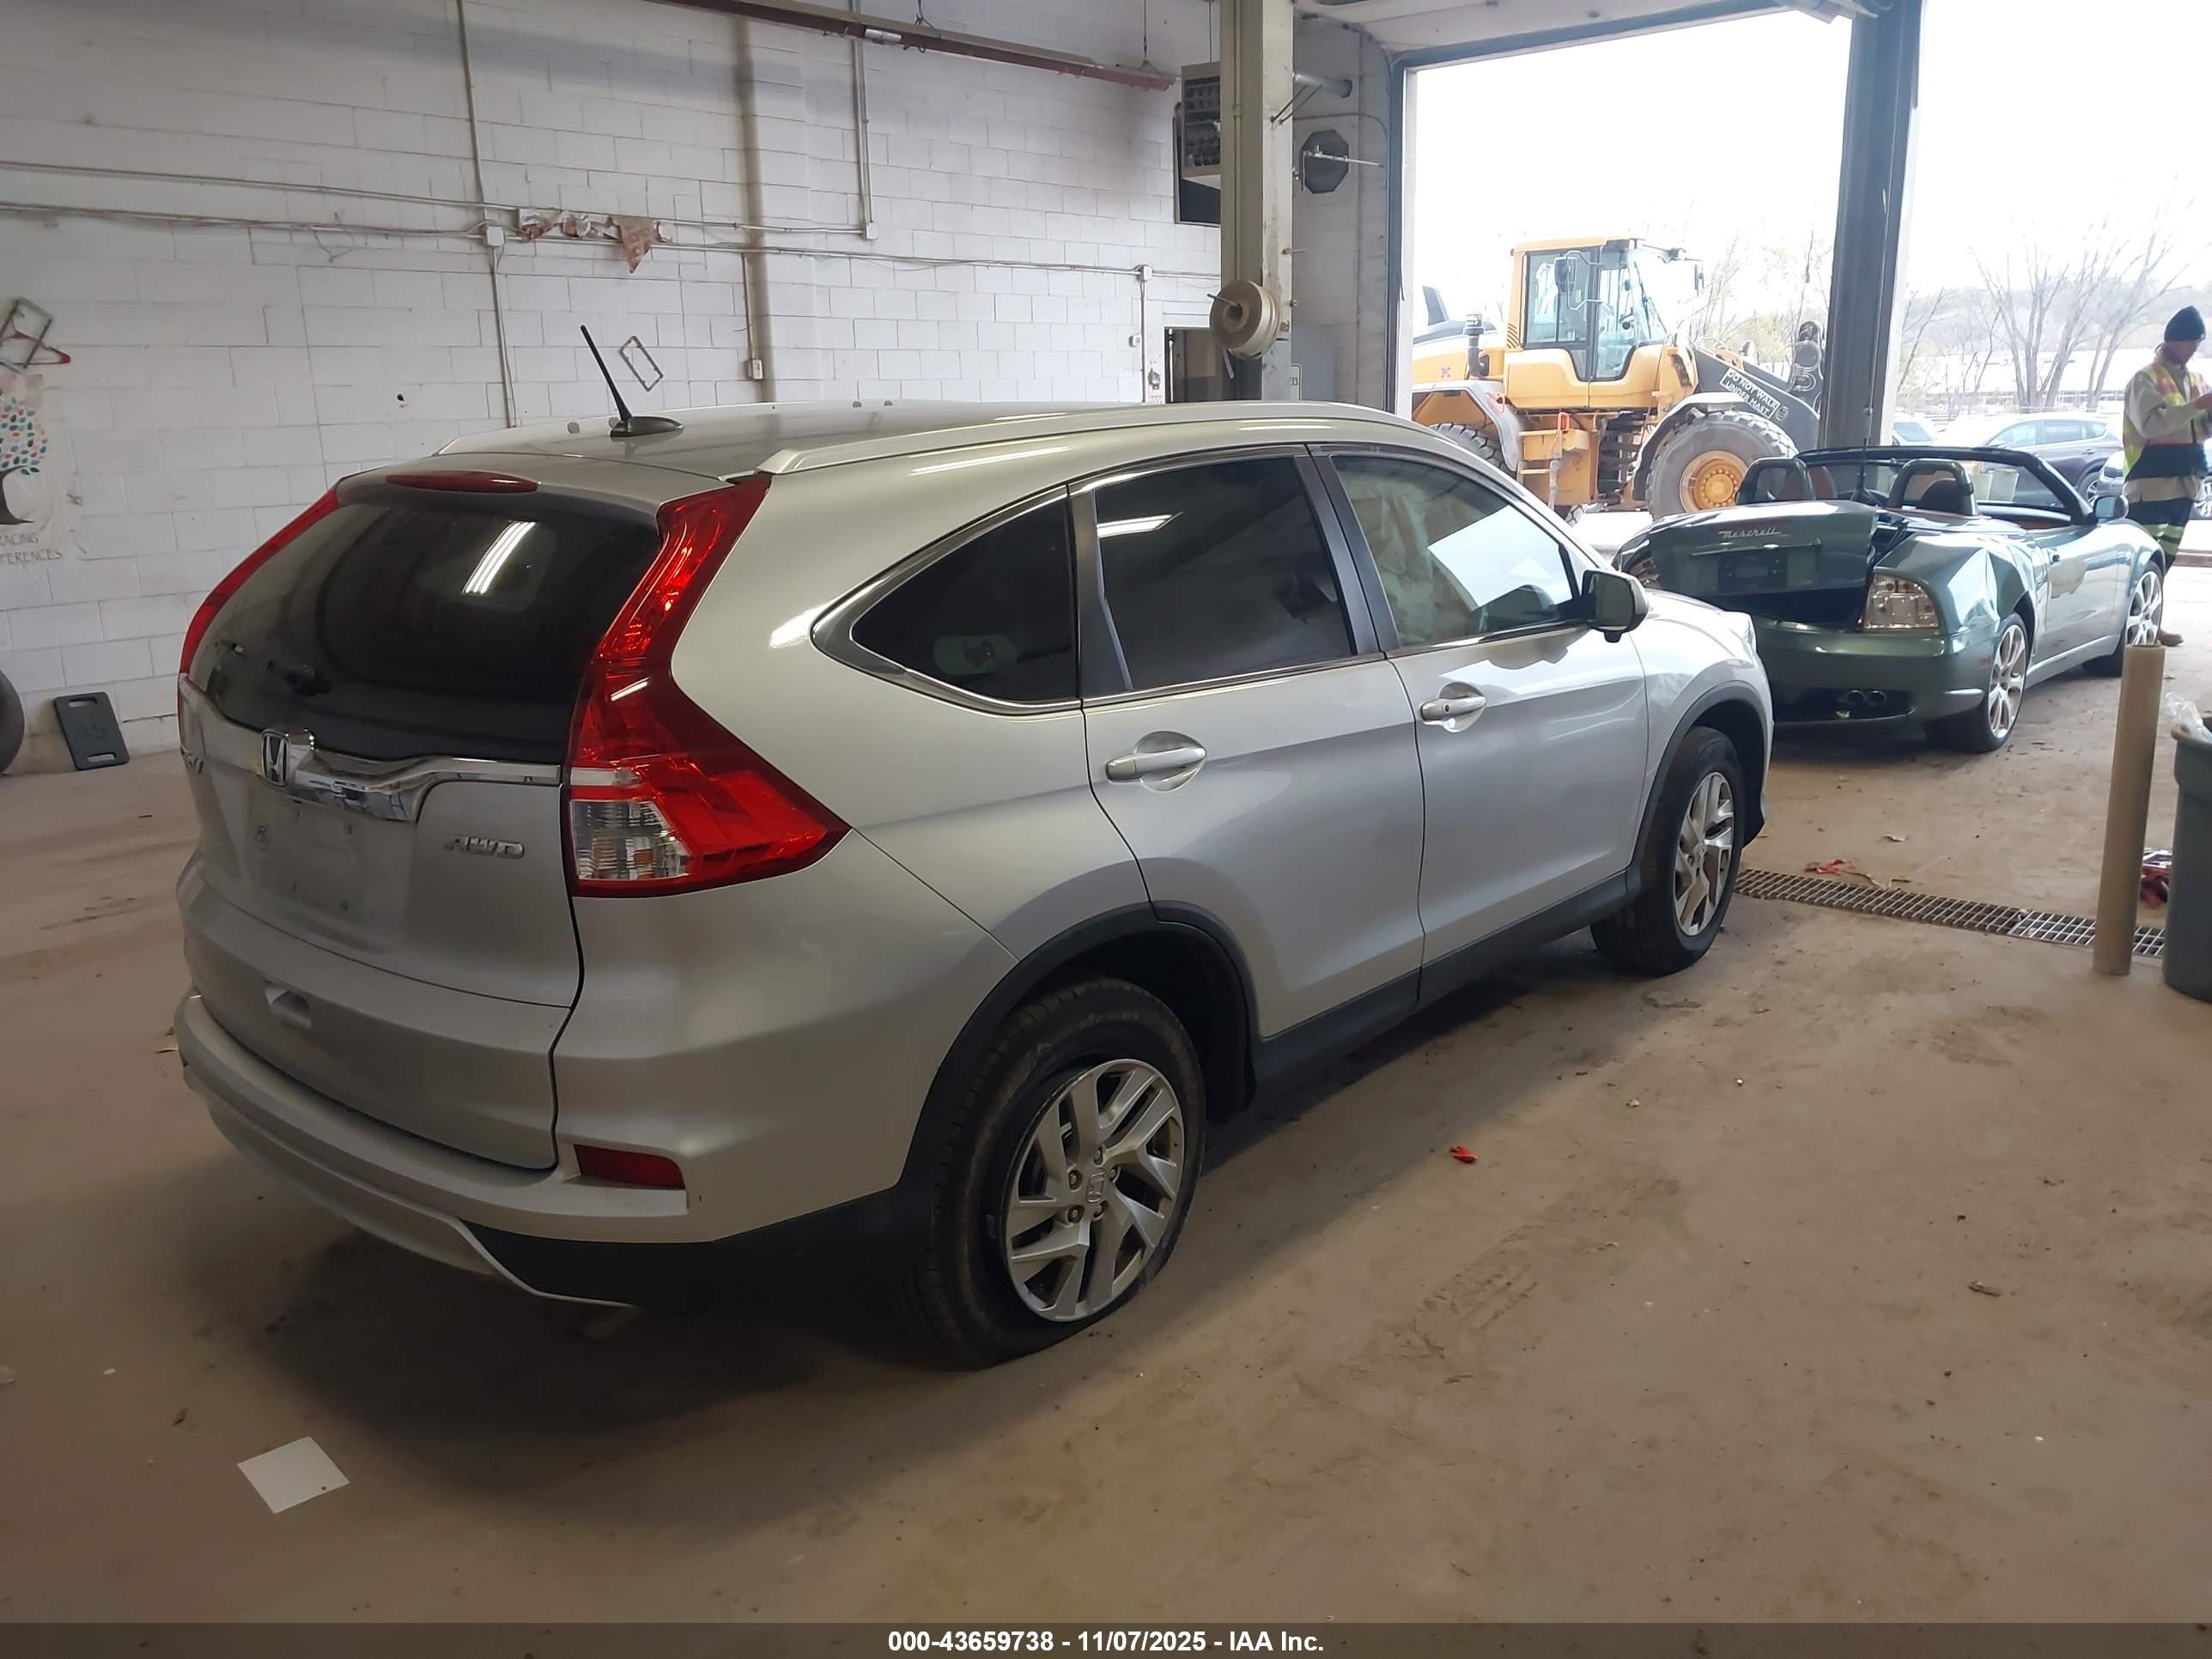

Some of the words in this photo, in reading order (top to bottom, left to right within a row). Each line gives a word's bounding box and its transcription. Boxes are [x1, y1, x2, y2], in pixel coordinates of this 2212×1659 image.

[1725, 380, 1750, 403] UNDER
[1749, 398, 1770, 416] MAST
[1727, 369, 1740, 382] DO
[1739, 378, 1758, 393] NOT
[1756, 389, 1778, 409] WALK
[442, 836, 525, 860] AWD
